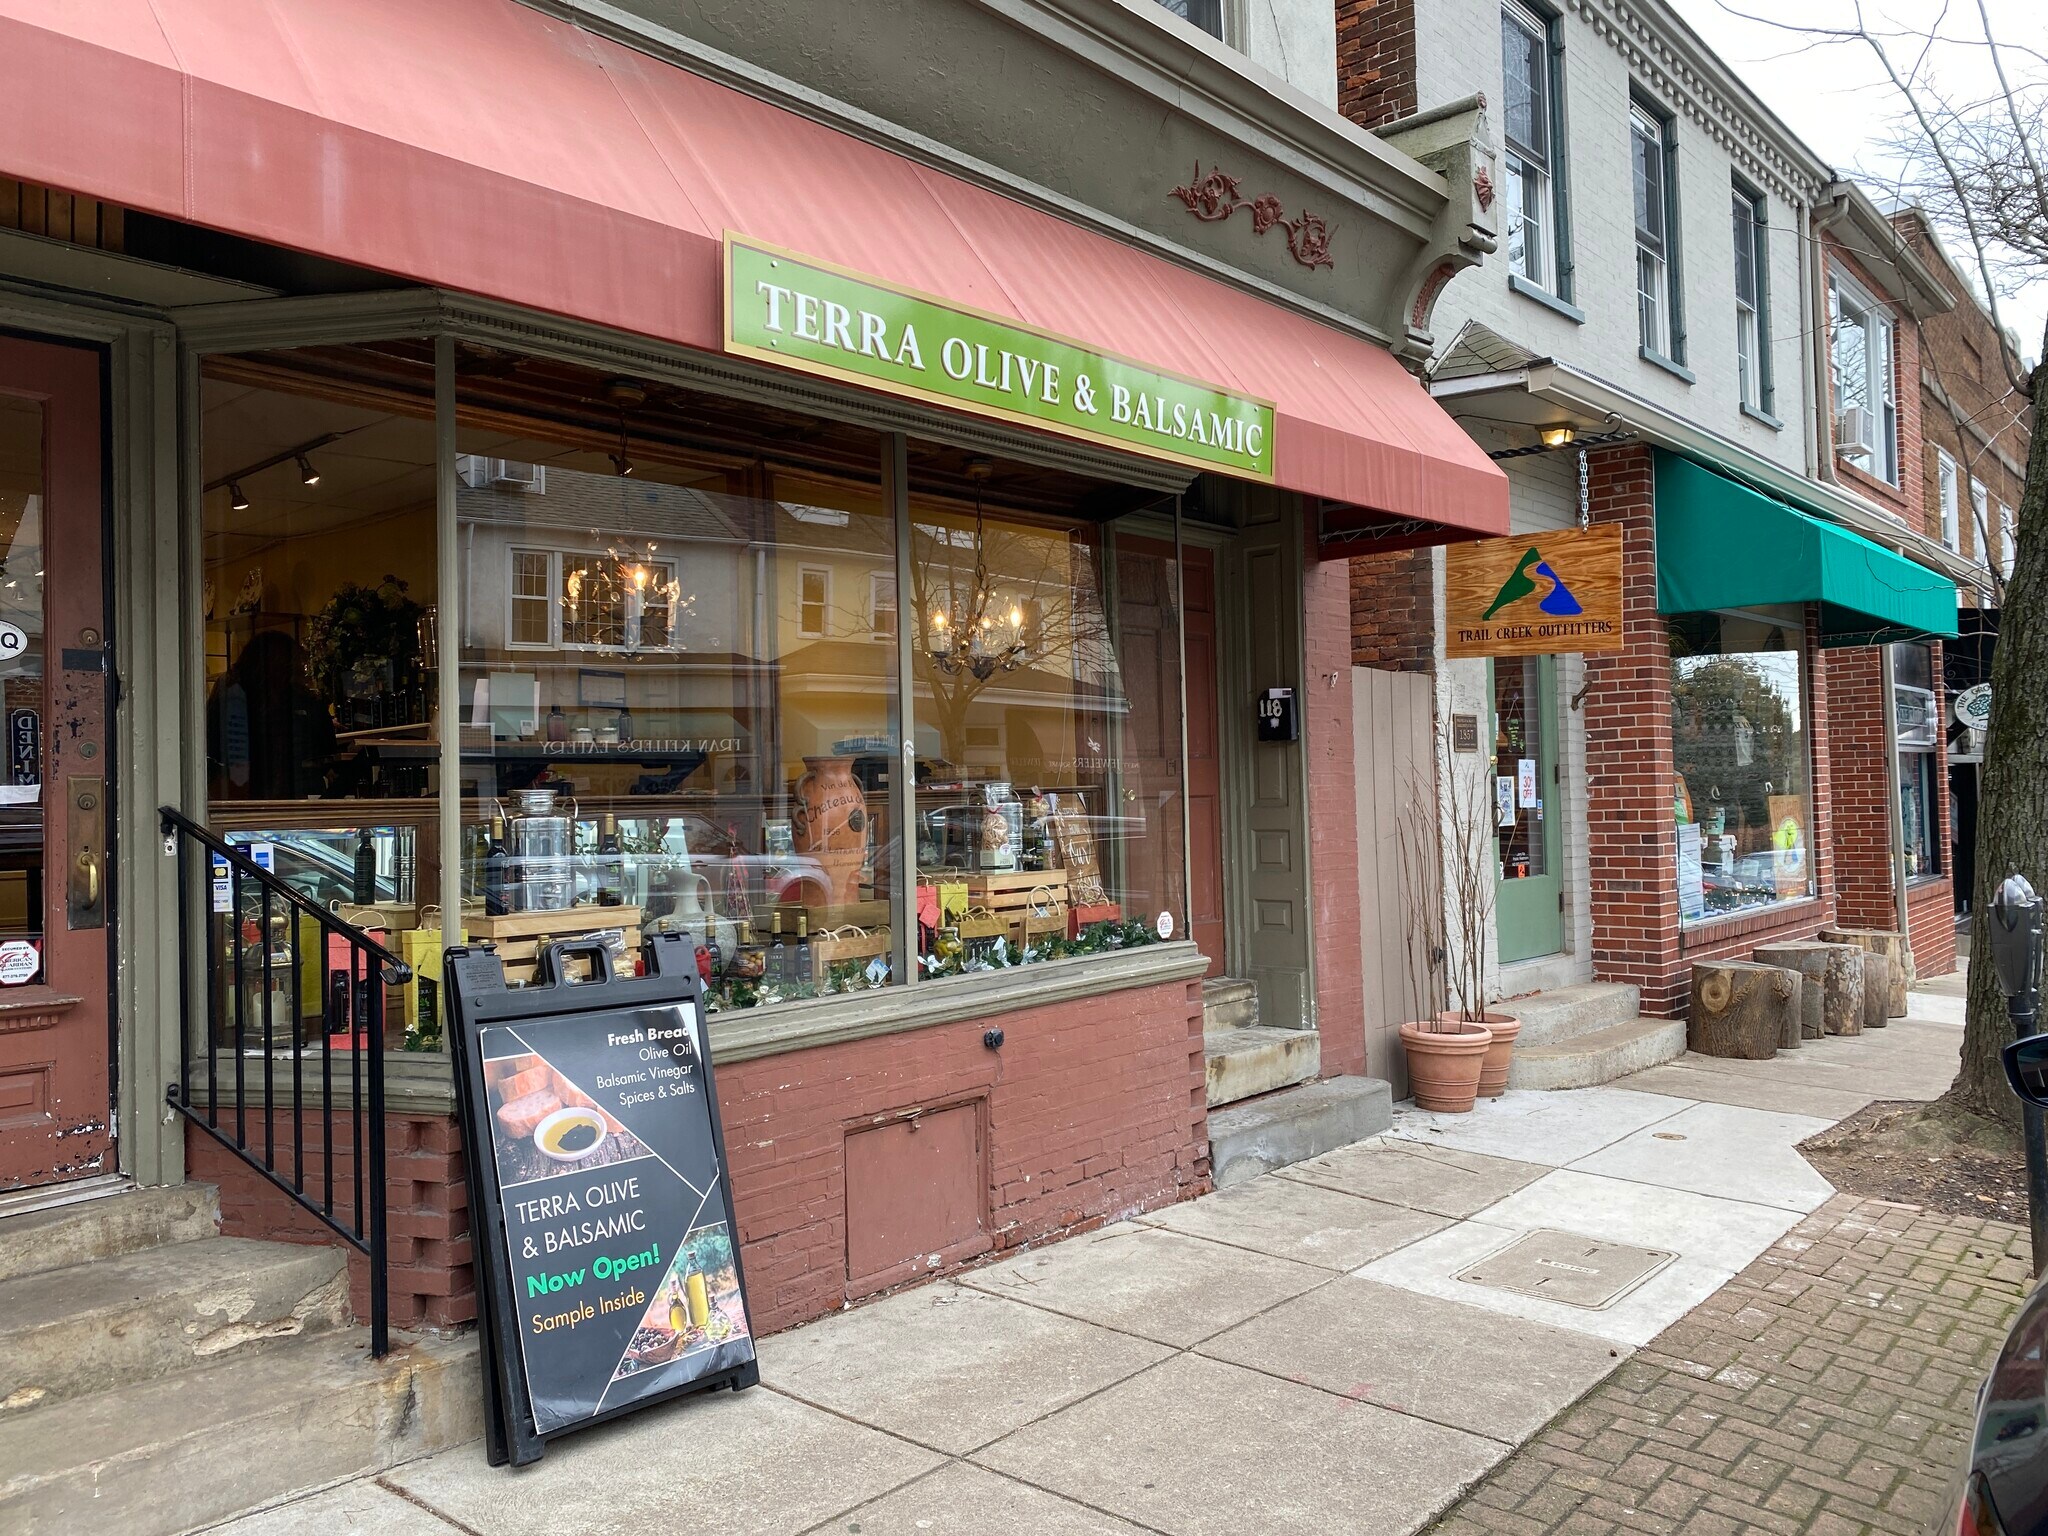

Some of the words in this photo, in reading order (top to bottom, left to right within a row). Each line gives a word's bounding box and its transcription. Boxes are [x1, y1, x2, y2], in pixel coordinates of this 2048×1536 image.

[755, 280, 926, 370] TERRA
[941, 336, 1060, 403] OLIVE
[1073, 373, 1098, 416] &
[1110, 383, 1263, 458] BALSAMIC
[1, 632, 19, 650] Q
[1458, 629, 1492, 642] TRAIL
[1496, 625, 1533, 640] CREEK
[1539, 621, 1612, 637] OUTFITTERS
[1259, 699, 1282, 717] 118
[1957, 694, 1969, 709] THE
[1971, 685, 1990, 694] GRO
[821, 783, 836, 791] Vin
[1523, 789, 1533, 799] OFF
[806, 795, 853, 823] Chateau
[608, 1029, 643, 1046] Fresh
[639, 1046, 669, 1061] Olive
[673, 1041, 692, 1056] Oil
[596, 1070, 647, 1089] Balsamic
[648, 1064, 693, 1080] Vinegar
[619, 1091, 655, 1108] Spices
[658, 1085, 668, 1098] &
[669, 1081, 695, 1096] Salts
[515, 1192, 581, 1224] TERRA
[585, 1177, 640, 1207] OLIVE
[522, 1236, 539, 1259] &
[544, 1209, 646, 1253] BALSAMIC
[526, 1268, 586, 1298] Now
[592, 1242, 661, 1282] Open!
[532, 1300, 595, 1334] Sample
[599, 1286, 645, 1315] Inside
